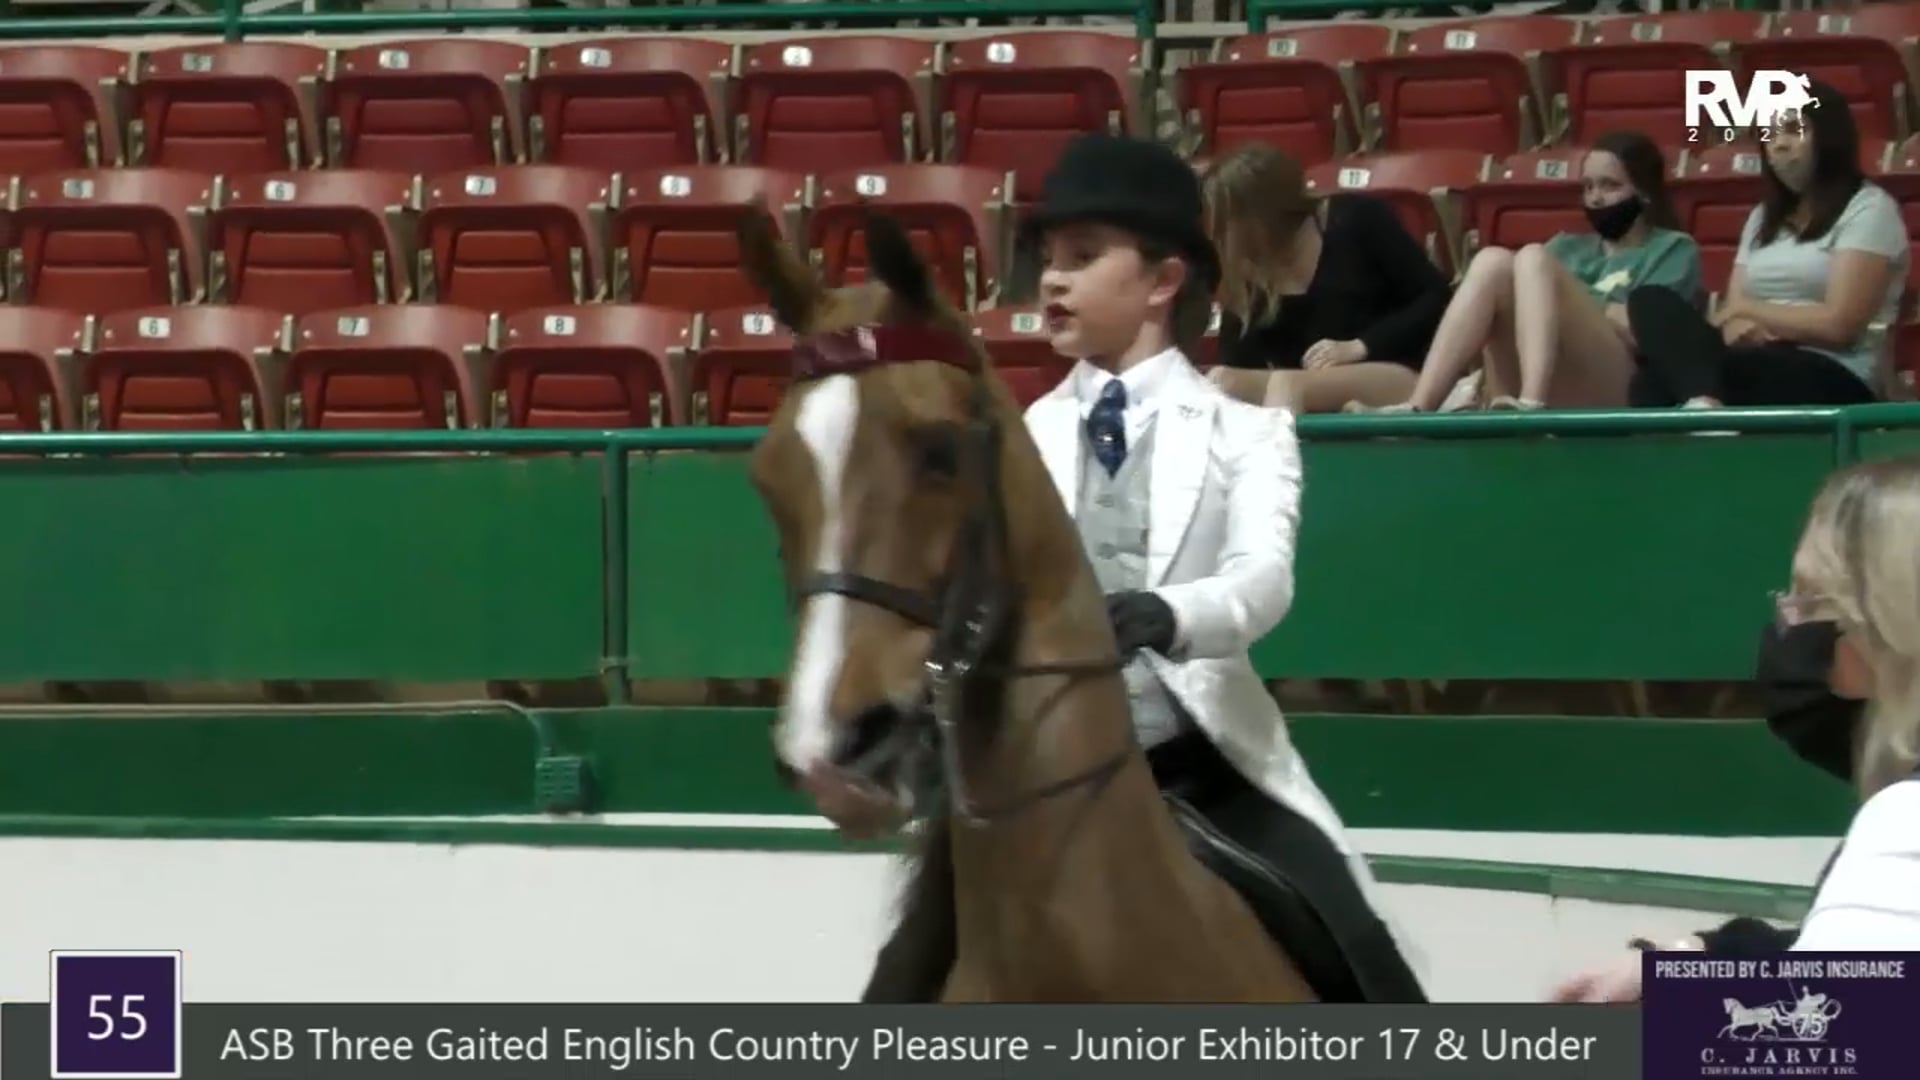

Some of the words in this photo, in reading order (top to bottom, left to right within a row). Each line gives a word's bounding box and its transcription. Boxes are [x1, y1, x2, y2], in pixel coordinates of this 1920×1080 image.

[1545, 162, 1560, 176] 12
[1349, 171, 1360, 185] 11
[275, 184, 283, 197] 6
[478, 178, 484, 193] 7
[866, 178, 875, 193] 9
[148, 319, 158, 335] 6
[350, 318, 360, 334] 7
[555, 318, 564, 332] 8
